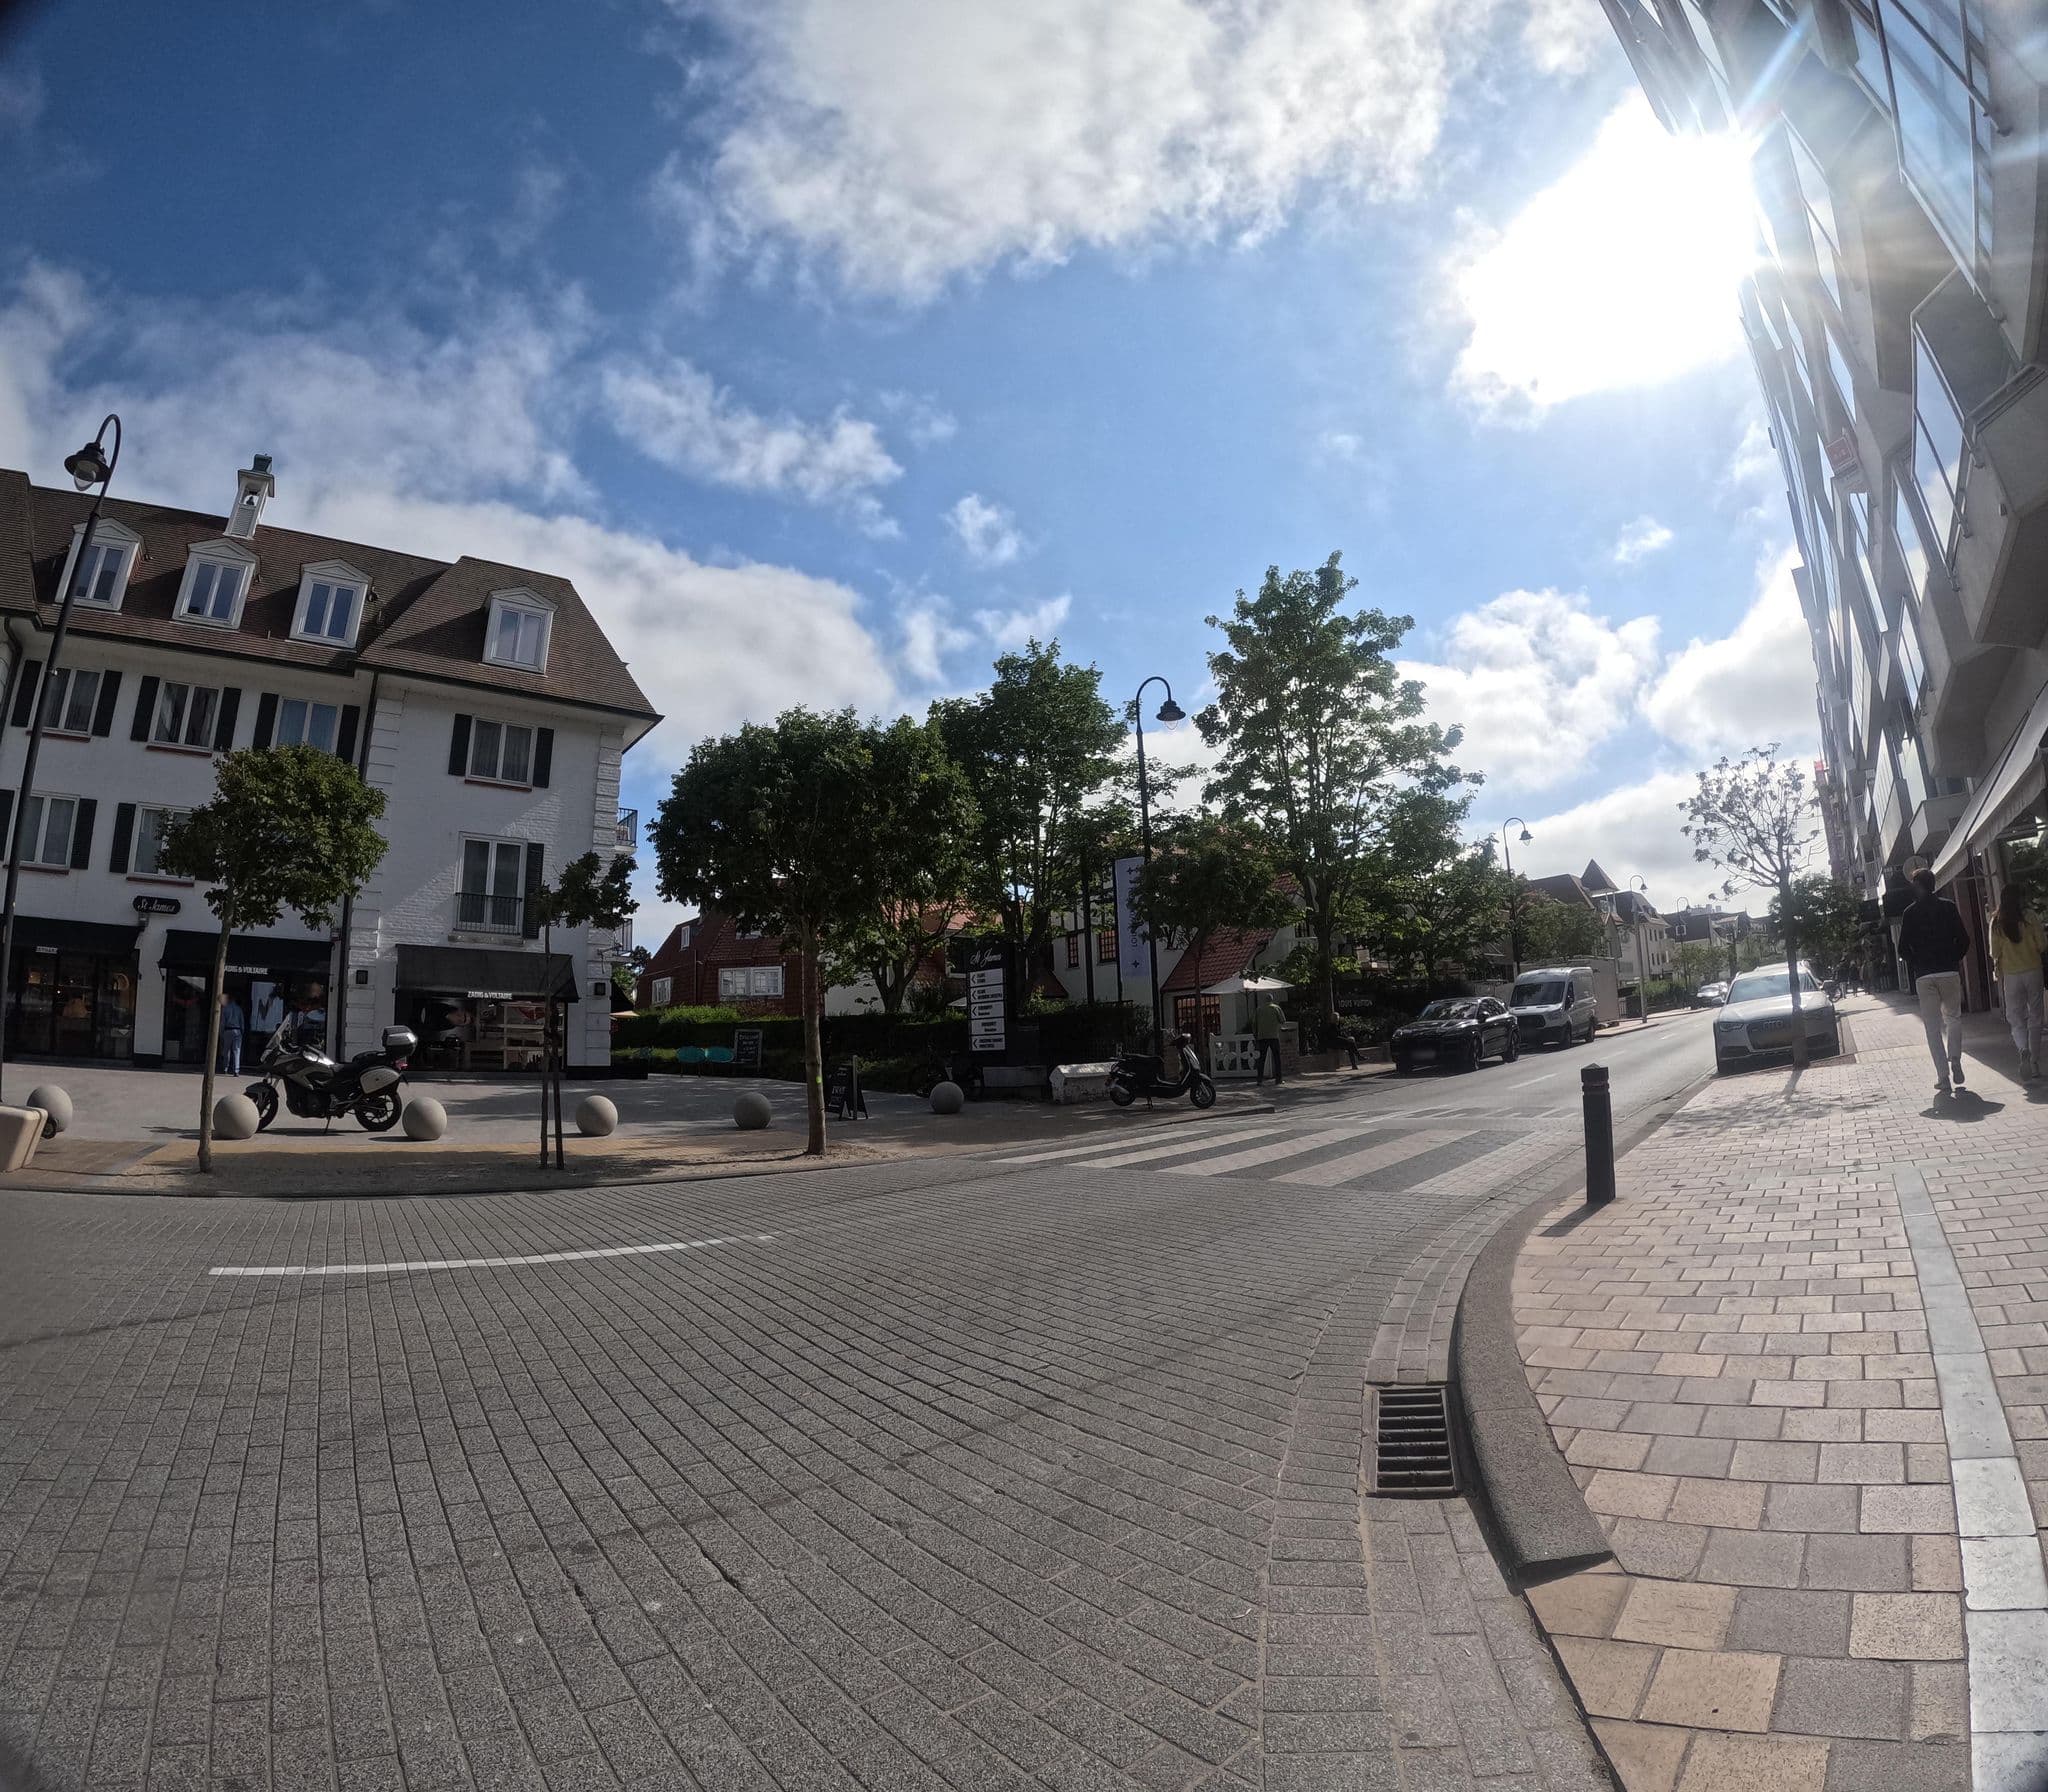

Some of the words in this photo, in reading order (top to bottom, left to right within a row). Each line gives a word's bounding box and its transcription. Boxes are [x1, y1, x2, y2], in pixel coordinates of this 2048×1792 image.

[224, 965, 238, 973] ADIG
[243, 966, 268, 975] VOLTAIRE
[467, 991, 484, 999] ZADIG
[489, 991, 513, 1000] VOLTAIRE
